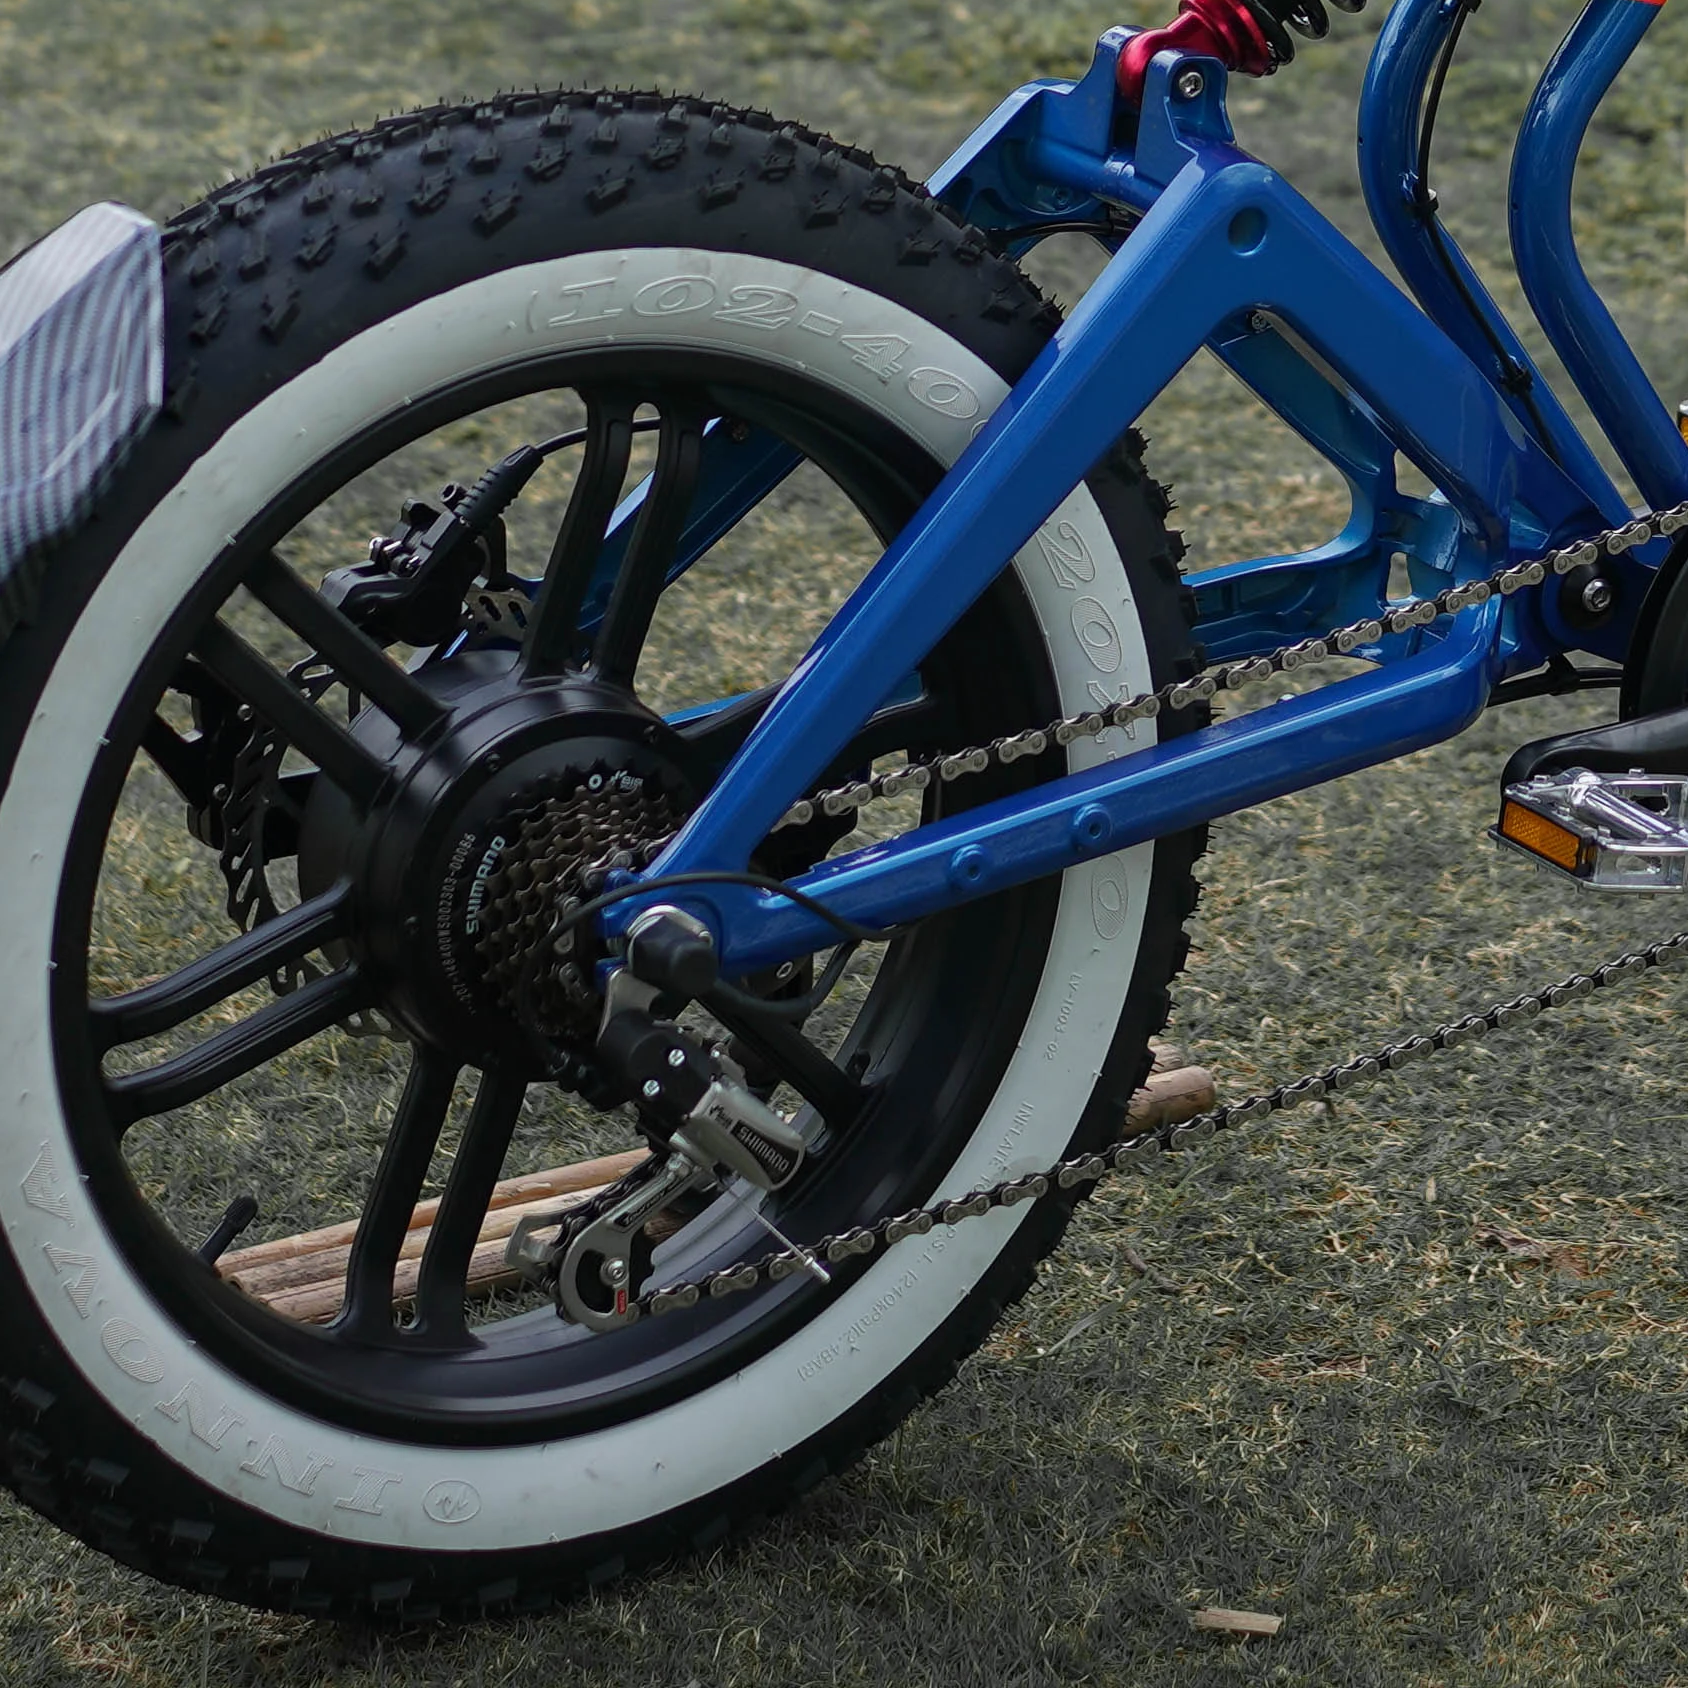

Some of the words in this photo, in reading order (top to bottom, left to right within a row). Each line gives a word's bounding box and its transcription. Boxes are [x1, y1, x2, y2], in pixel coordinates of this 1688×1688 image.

[466, 835, 506, 935] SHIMANO
[737, 1129, 789, 1174] SHIMANO
[20, 1141, 403, 1515] INNOVA
